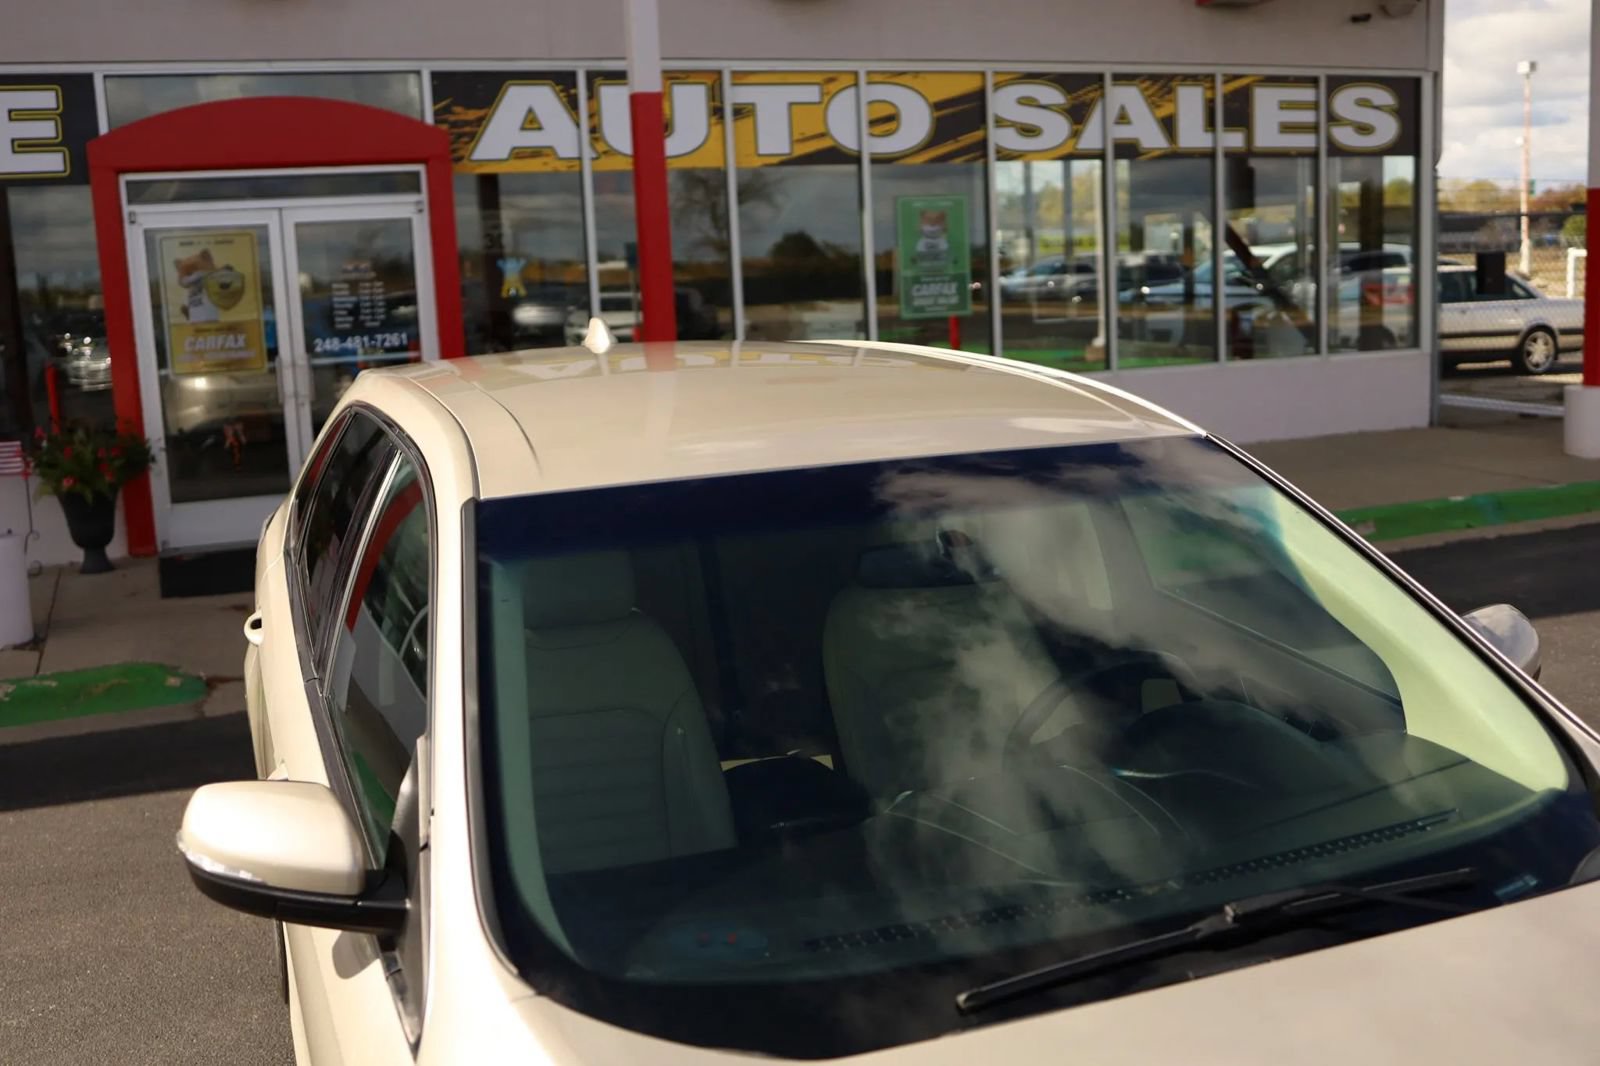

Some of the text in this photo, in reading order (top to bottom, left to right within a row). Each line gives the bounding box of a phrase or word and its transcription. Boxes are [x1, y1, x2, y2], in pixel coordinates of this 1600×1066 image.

[469, 80, 1400, 160] AUTO SALES
[184, 334, 247, 351] CARFAX
